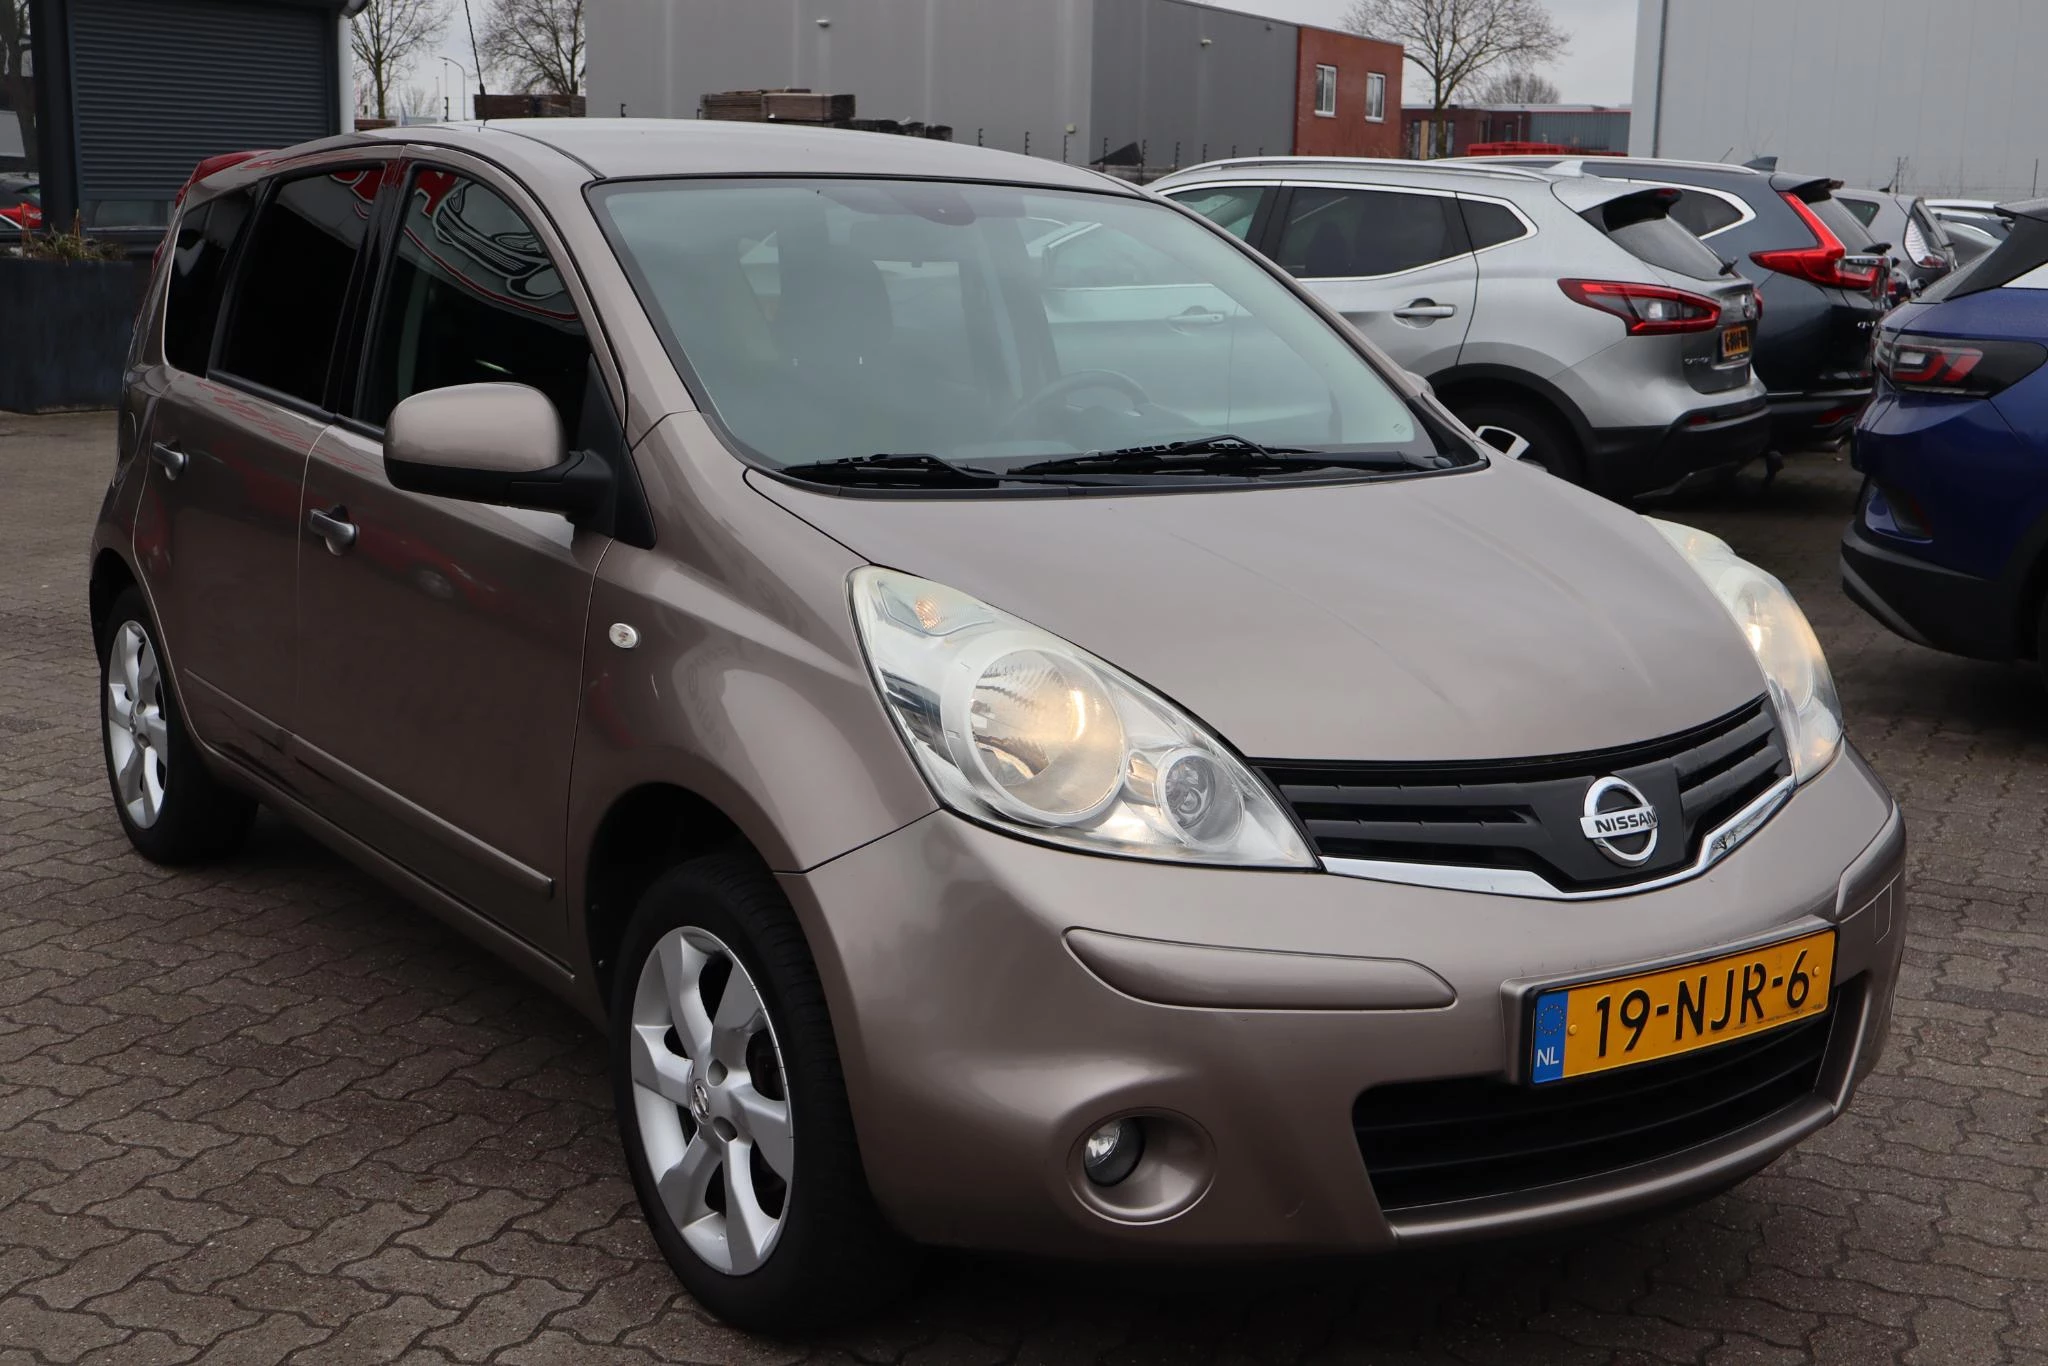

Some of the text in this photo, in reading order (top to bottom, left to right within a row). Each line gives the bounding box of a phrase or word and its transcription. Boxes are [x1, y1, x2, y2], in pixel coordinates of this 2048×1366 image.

[1594, 808, 1657, 834] NISSAN
[1595, 950, 1811, 1058] 19-NJR-6
[1536, 1046, 1560, 1068] NL
